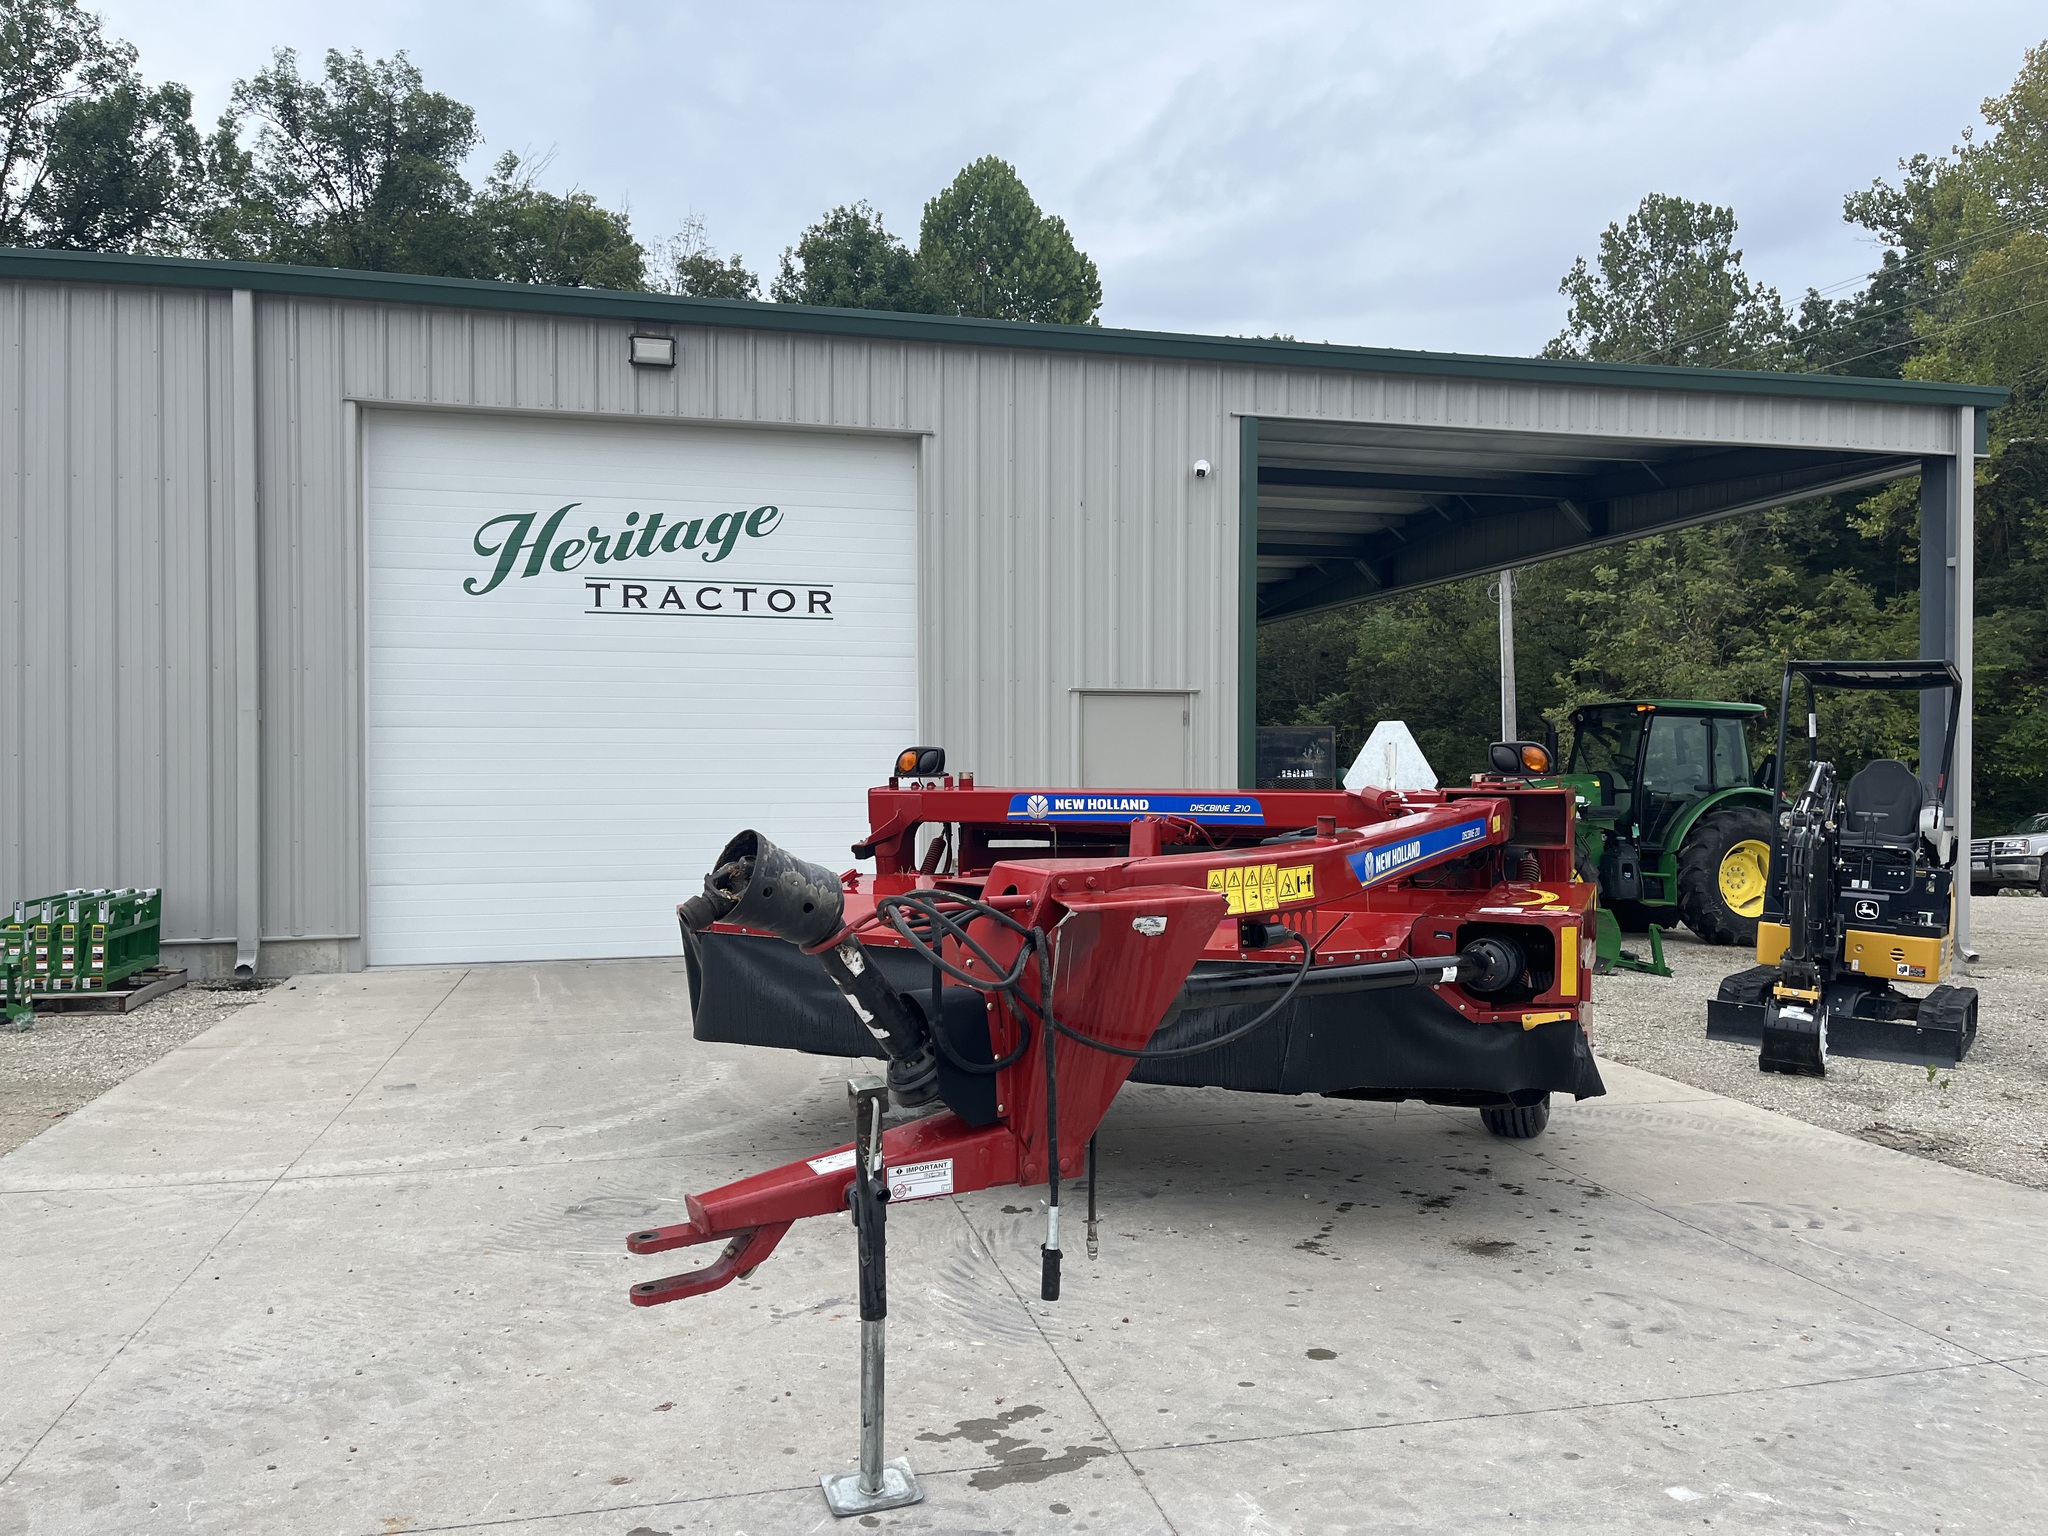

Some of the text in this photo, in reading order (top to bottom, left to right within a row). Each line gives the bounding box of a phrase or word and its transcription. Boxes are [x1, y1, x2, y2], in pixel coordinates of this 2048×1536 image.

[463, 502, 784, 596] Heritage
[585, 582, 833, 614] TRACTOR
[1055, 798, 1149, 811] NEW HOLLAND
[1190, 804, 1251, 813] DISCBINE 210
[1375, 840, 1421, 873] NEW HOLLAND
[905, 1161, 948, 1174] IMPORTANT
